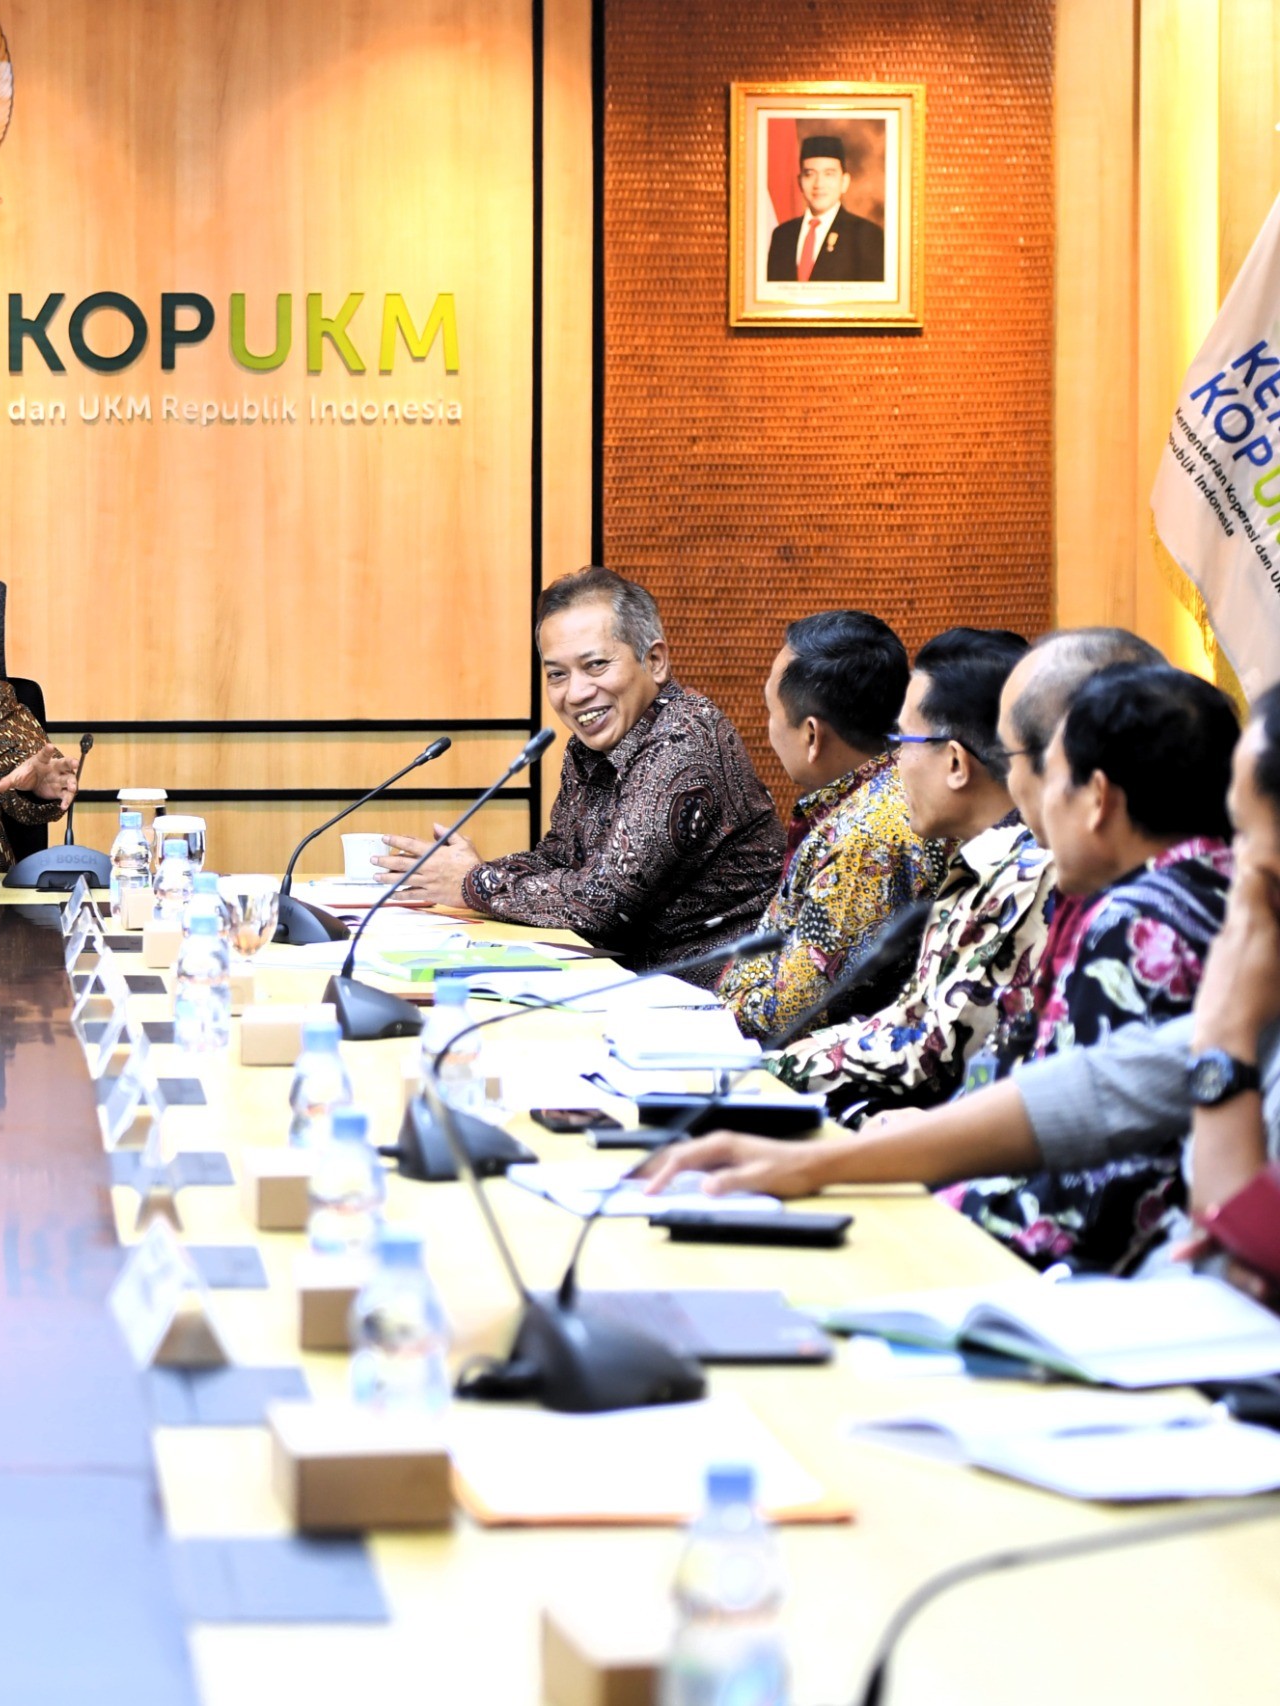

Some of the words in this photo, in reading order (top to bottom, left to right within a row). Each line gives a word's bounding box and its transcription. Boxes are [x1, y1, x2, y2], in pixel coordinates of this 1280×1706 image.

[9, 394, 67, 422] dan
[79, 394, 152, 422] UKM
[161, 393, 297, 426] Republik
[310, 393, 463, 422] Indonesia
[1194, 474, 1234, 537] Indonesia
[1225, 483, 1260, 542] Koperasi
[1255, 544, 1273, 571] dan
[56, 854, 97, 865] BOSCH
